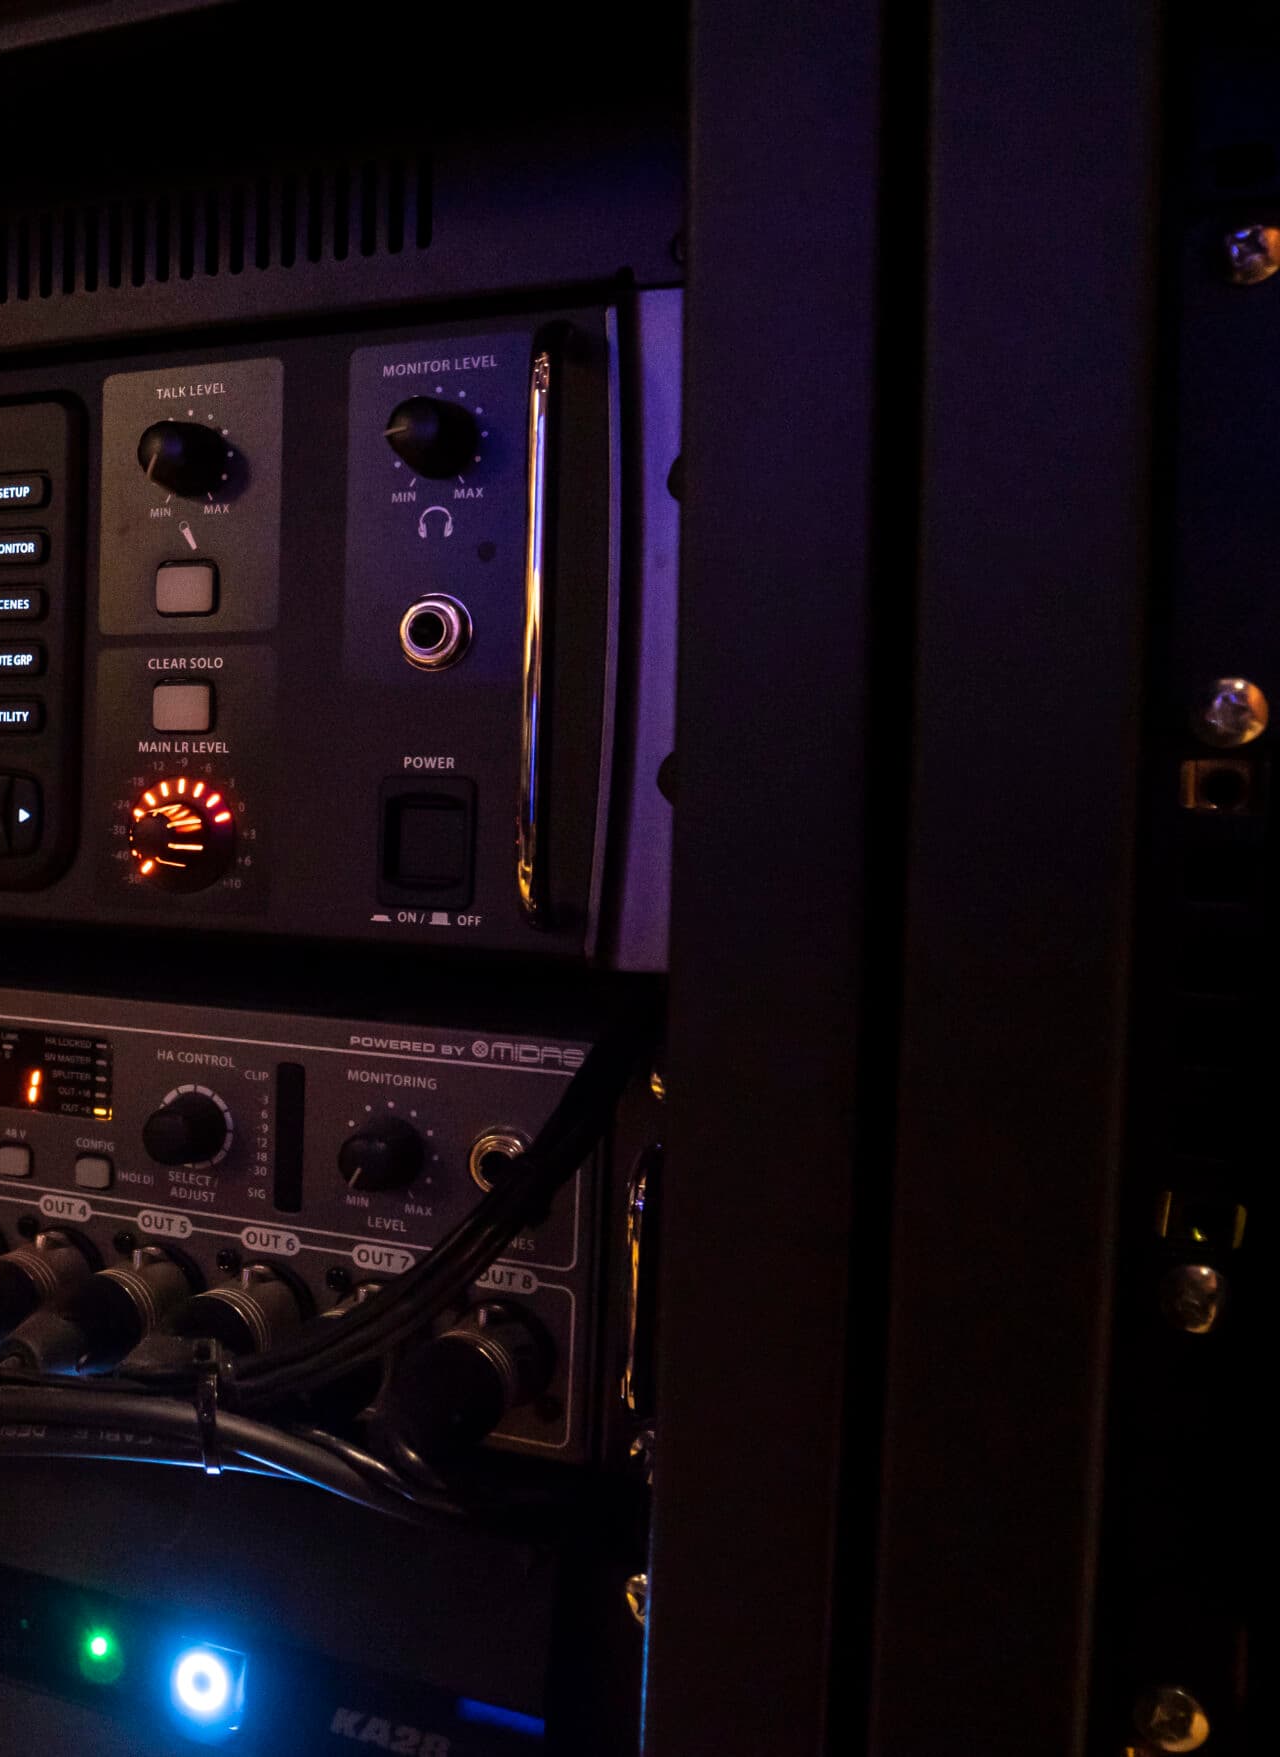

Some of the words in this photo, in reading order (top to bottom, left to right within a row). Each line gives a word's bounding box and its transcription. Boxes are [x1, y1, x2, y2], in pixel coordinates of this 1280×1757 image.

[382, 360, 451, 378] MONITOR
[455, 354, 498, 371] LEVEL
[156, 385, 187, 400] TALK
[189, 383, 226, 398] LEVEL
[391, 491, 417, 504] MIN
[454, 487, 484, 500] MAX
[150, 507, 171, 518] MIN
[203, 503, 230, 515] MAX
[12, 654, 33, 667] GRP
[148, 657, 188, 670] CLEAR
[190, 656, 224, 670] SOLO
[138, 741, 171, 754] MAIN
[174, 741, 189, 754] LR
[192, 741, 230, 754] LEVEL
[403, 756, 456, 770] POWER
[397, 912, 419, 924] ON
[457, 914, 483, 927] OFF
[157, 1049, 174, 1062] HA
[177, 1051, 236, 1068] CONTROL
[349, 1035, 436, 1053] POWERED
[440, 1043, 466, 1056] BY
[490, 1042, 585, 1068] MIDAS
[244, 1070, 269, 1081] CLIP
[347, 1069, 438, 1091] MONITORING
[76, 1137, 115, 1152] CONFIG
[168, 1171, 212, 1187] SELECT
[169, 1186, 217, 1203] ADJUST
[247, 1187, 266, 1199] SIG
[43, 1198, 74, 1214] OUT
[77, 1204, 87, 1218] 4
[345, 1194, 370, 1208] MIN
[404, 1203, 433, 1217] MAX
[141, 1214, 174, 1231] OUT
[178, 1219, 188, 1234] 5
[367, 1216, 408, 1233] LEVEL
[246, 1231, 282, 1248] OUT
[286, 1237, 296, 1252] 6
[357, 1250, 395, 1267] OUT
[399, 1255, 411, 1270] 7
[522, 1275, 532, 1289] 8
